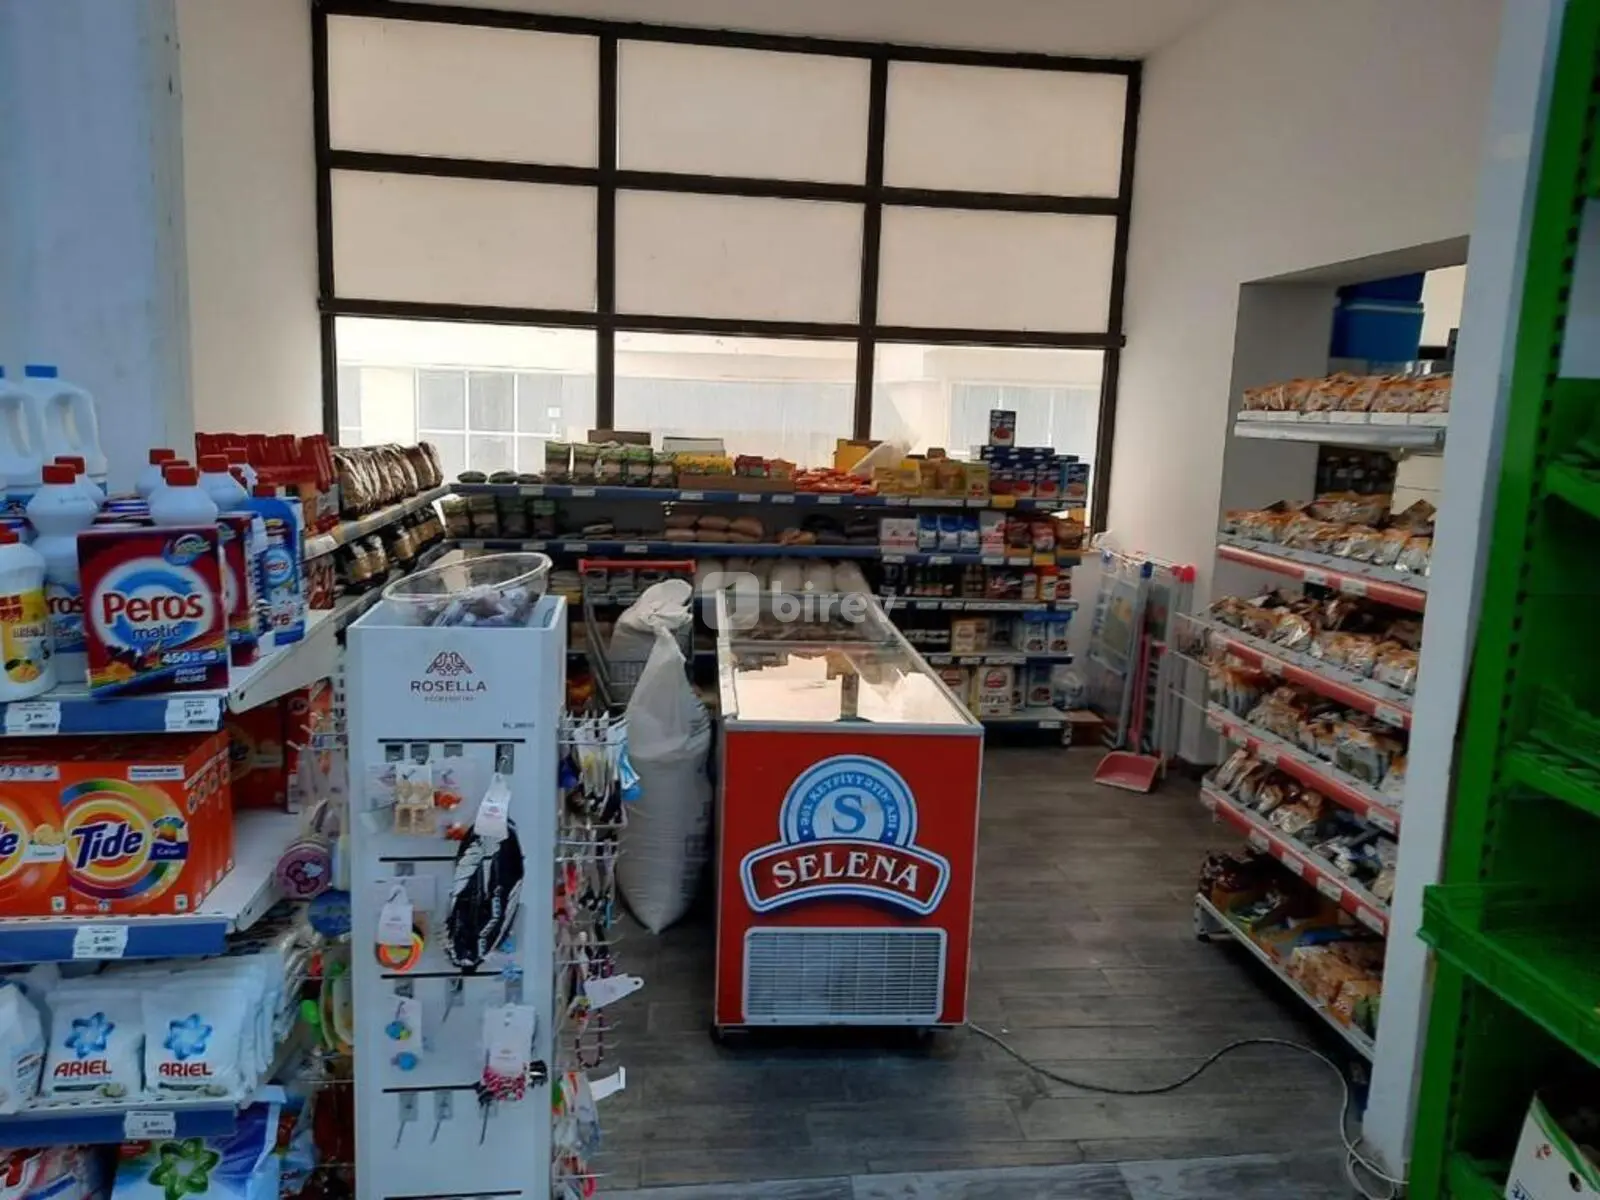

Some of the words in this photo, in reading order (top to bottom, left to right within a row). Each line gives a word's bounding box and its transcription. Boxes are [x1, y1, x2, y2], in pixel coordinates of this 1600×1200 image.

[47, 596, 84, 615] ros
[102, 592, 204, 624] Peros
[132, 624, 181, 639] matic
[410, 680, 487, 692] ROSELLA
[832, 794, 866, 833] S
[71, 822, 144, 869] Tide
[772, 851, 920, 892] SELENA
[53, 1060, 112, 1077] ARIEL
[158, 1062, 213, 1077] ARIEL
